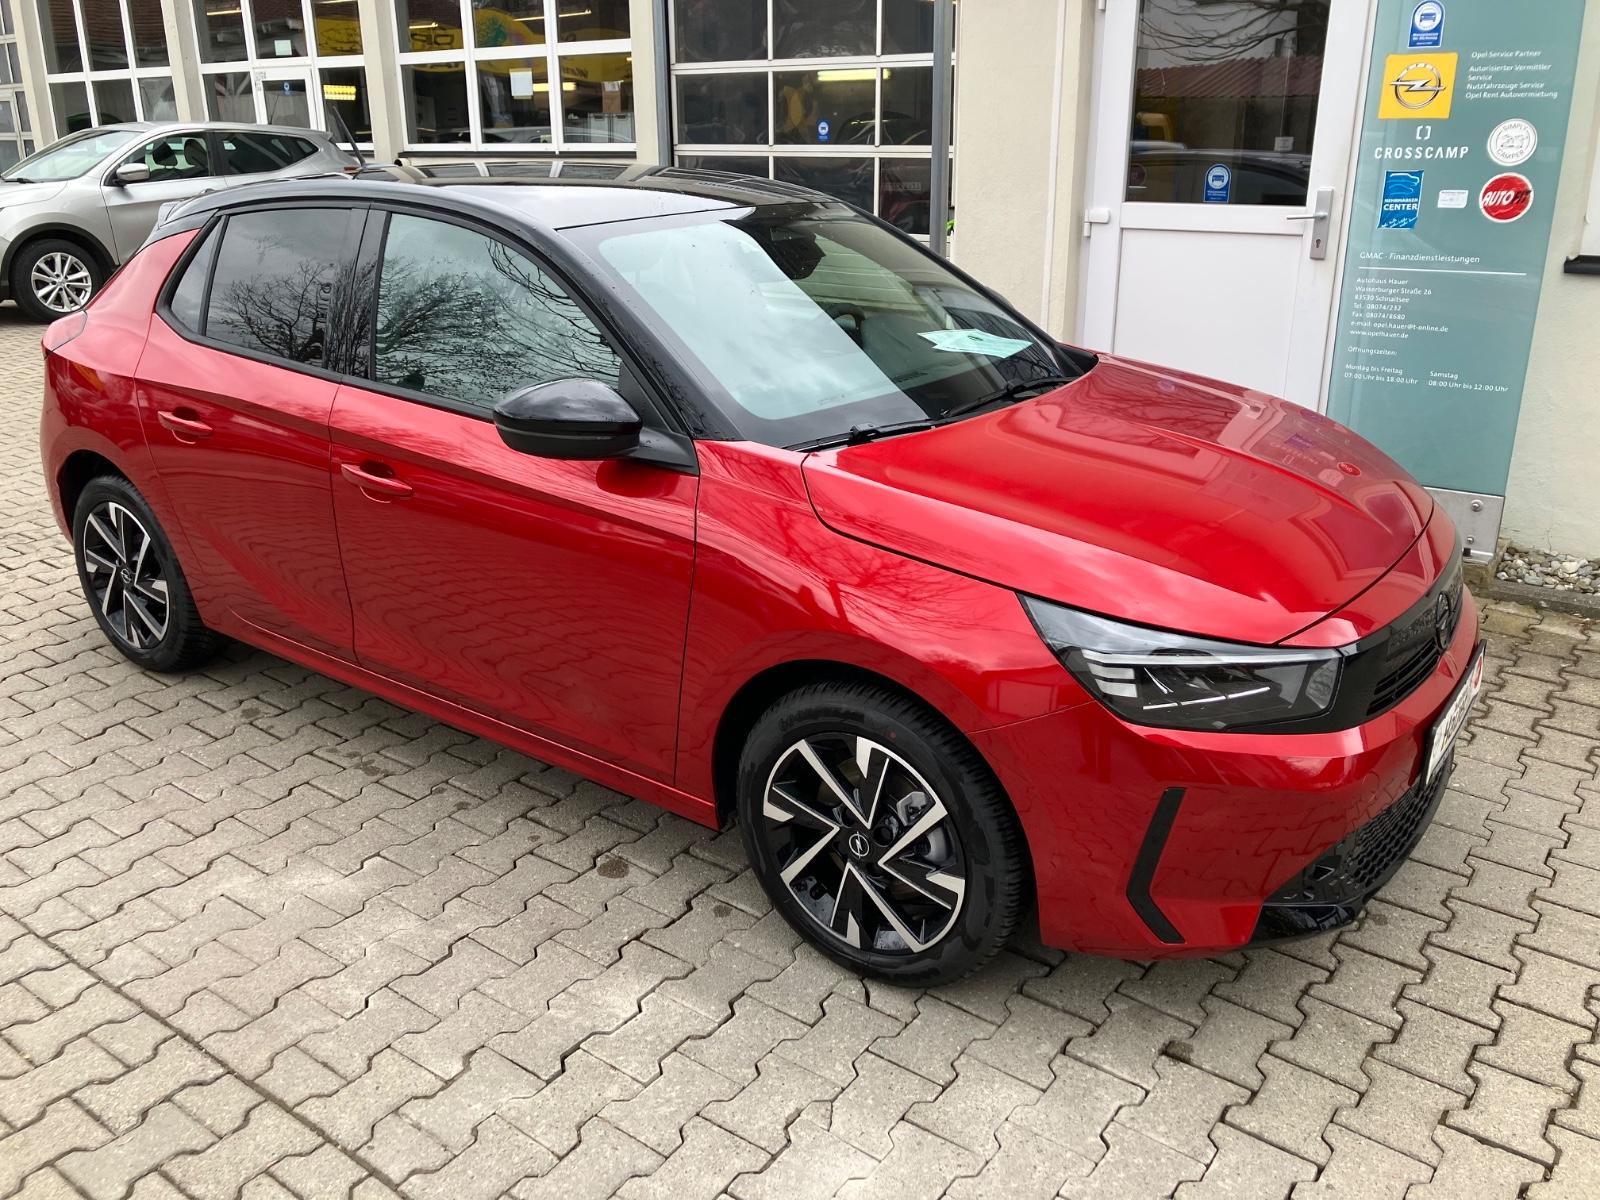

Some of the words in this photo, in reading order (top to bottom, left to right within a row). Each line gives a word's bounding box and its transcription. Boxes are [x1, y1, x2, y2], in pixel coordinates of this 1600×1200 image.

[1471, 51, 1487, 60] Opel
[1514, 64, 1552, 72] Vermittler
[1465, 92, 1482, 100] Opel
[1500, 91, 1558, 100] Autovermietung
[1374, 146, 1469, 159] CROSSCAMP
[1383, 203, 1418, 211] CENTER
[1360, 252, 1384, 260] GMAC
[1389, 252, 1480, 264] Finanzdienstleistungen
[1355, 286, 1400, 295] Wasserburger
[1345, 364, 1369, 372] Montag
[1381, 366, 1403, 375] Freitag
[1430, 371, 1458, 380] Samstag
[1463, 382, 1472, 390] bis
